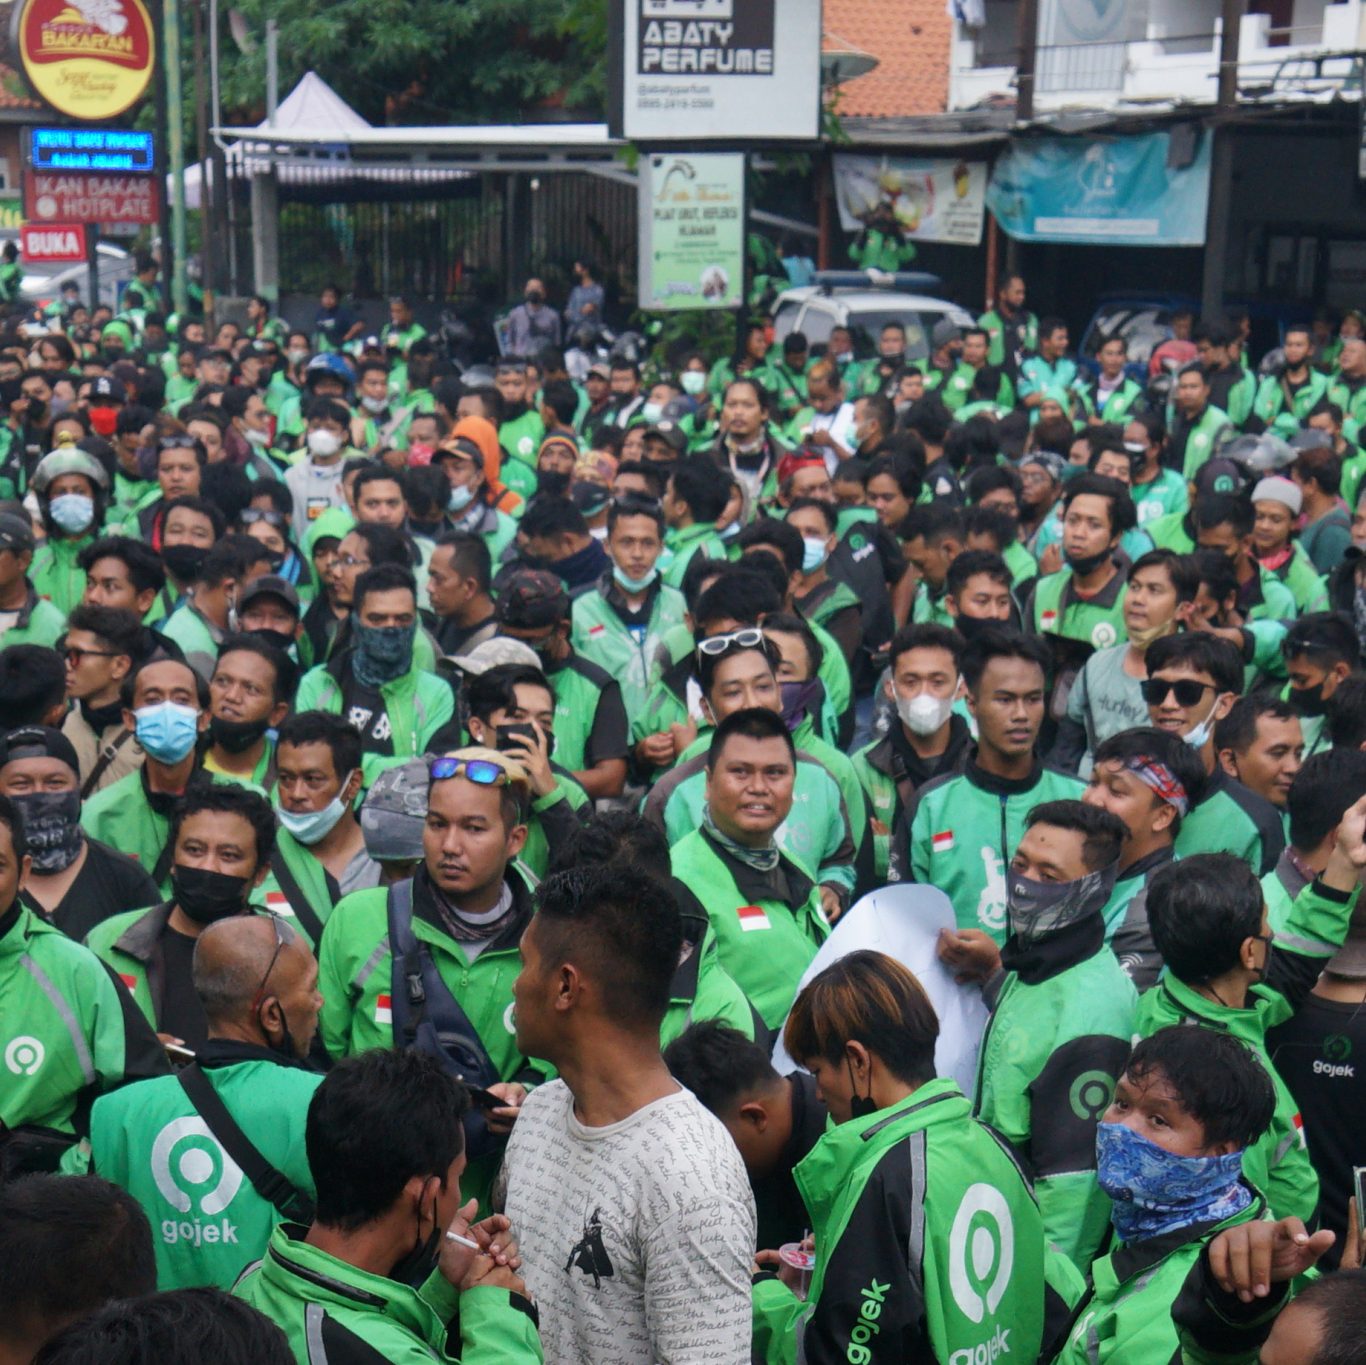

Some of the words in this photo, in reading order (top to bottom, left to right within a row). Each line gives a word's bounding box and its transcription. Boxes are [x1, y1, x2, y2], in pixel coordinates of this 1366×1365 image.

[643, 20, 734, 46] ABATY
[643, 47, 772, 73] PERFUME
[36, 176, 84, 195] IKAN
[88, 177, 151, 196] BAKAR
[63, 199, 152, 218] HOTPLATE
[27, 231, 79, 256] BUKA
[1312, 1059, 1355, 1078] gojek
[161, 1217, 239, 1248] gojek
